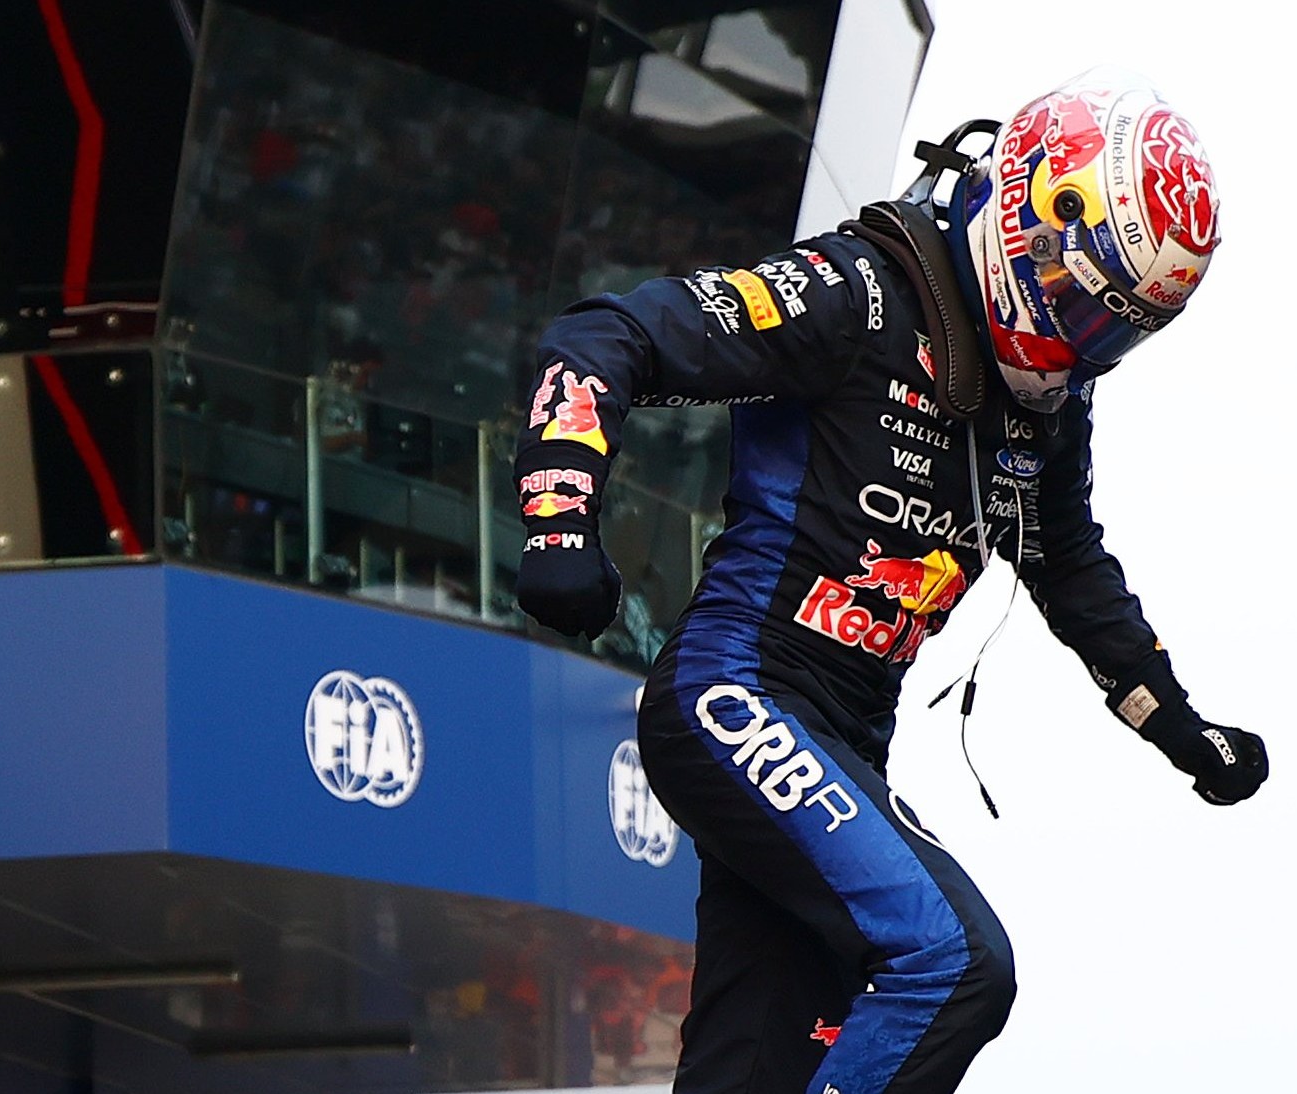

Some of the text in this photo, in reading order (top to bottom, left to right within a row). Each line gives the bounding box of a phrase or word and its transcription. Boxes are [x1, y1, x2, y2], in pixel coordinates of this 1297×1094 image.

[854, 257, 883, 330] sparco
[1009, 334, 1034, 368] indeed
[879, 414, 952, 450] CARLYLE
[890, 445, 932, 477] VISA
